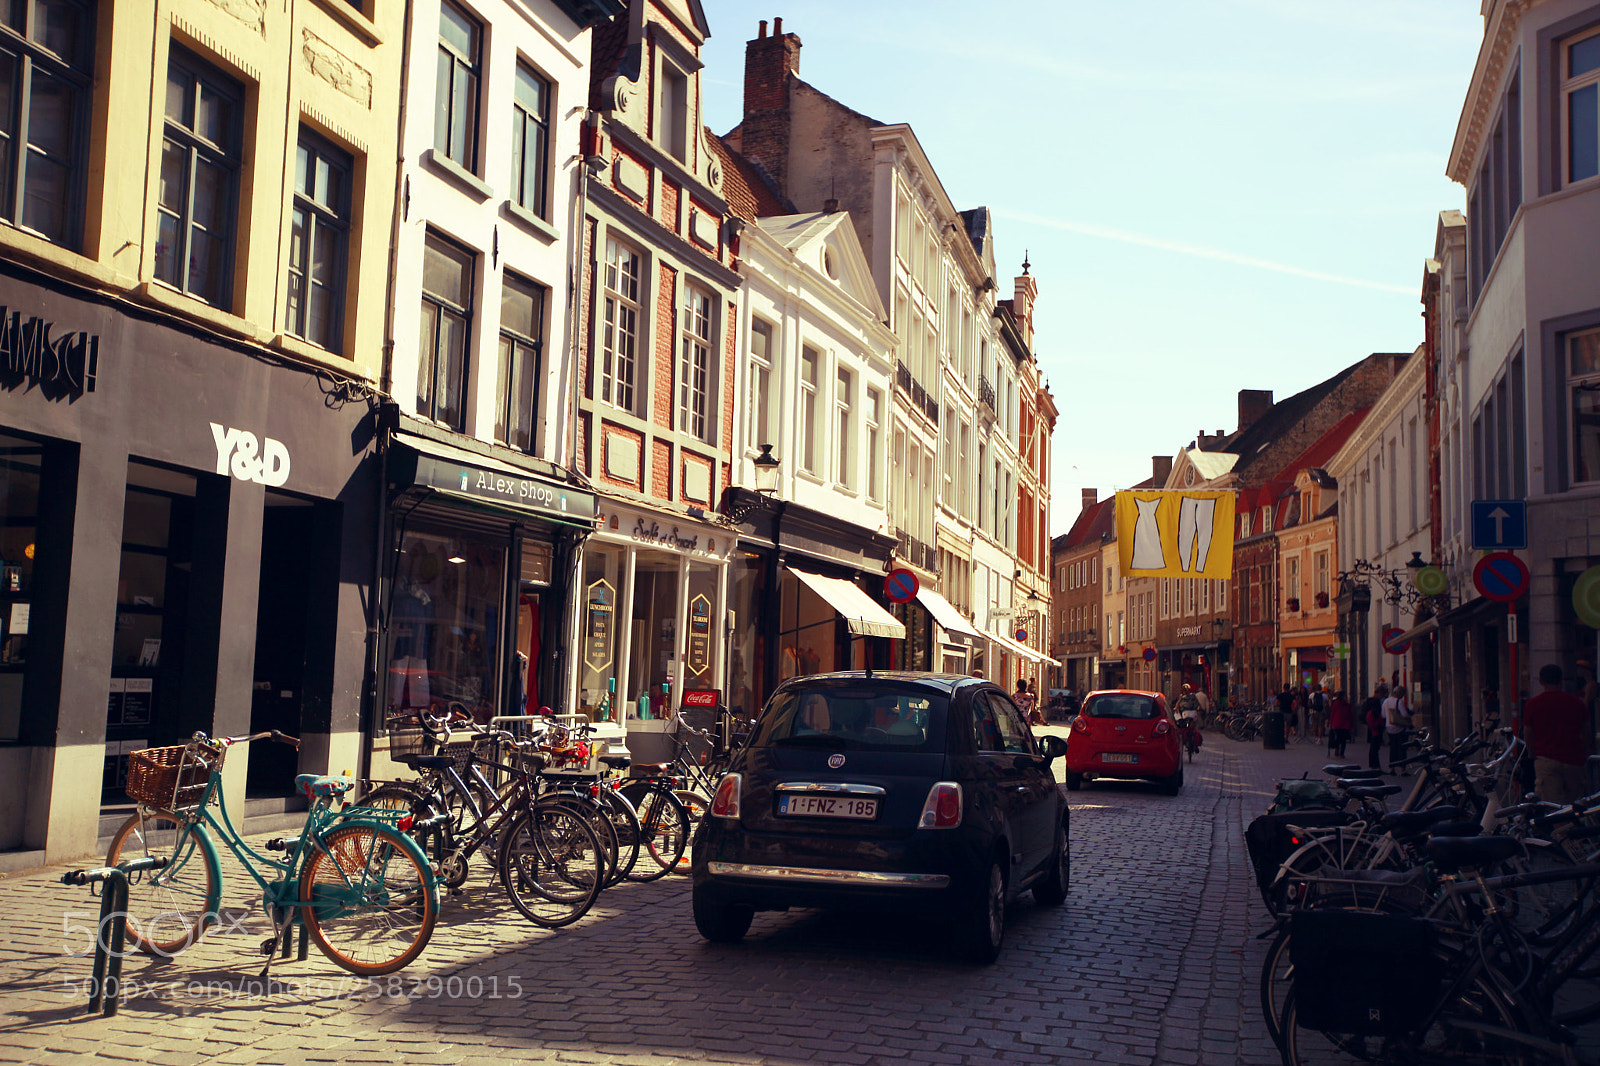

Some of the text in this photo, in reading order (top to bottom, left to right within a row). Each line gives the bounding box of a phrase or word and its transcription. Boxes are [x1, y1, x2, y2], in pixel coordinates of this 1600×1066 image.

[210, 422, 291, 488] Y&D
[476, 471, 554, 507] Alex Shop
[1176, 625, 1202, 638] SUPERMARKT
[791, 798, 876, 816] 1-FNZ-185
